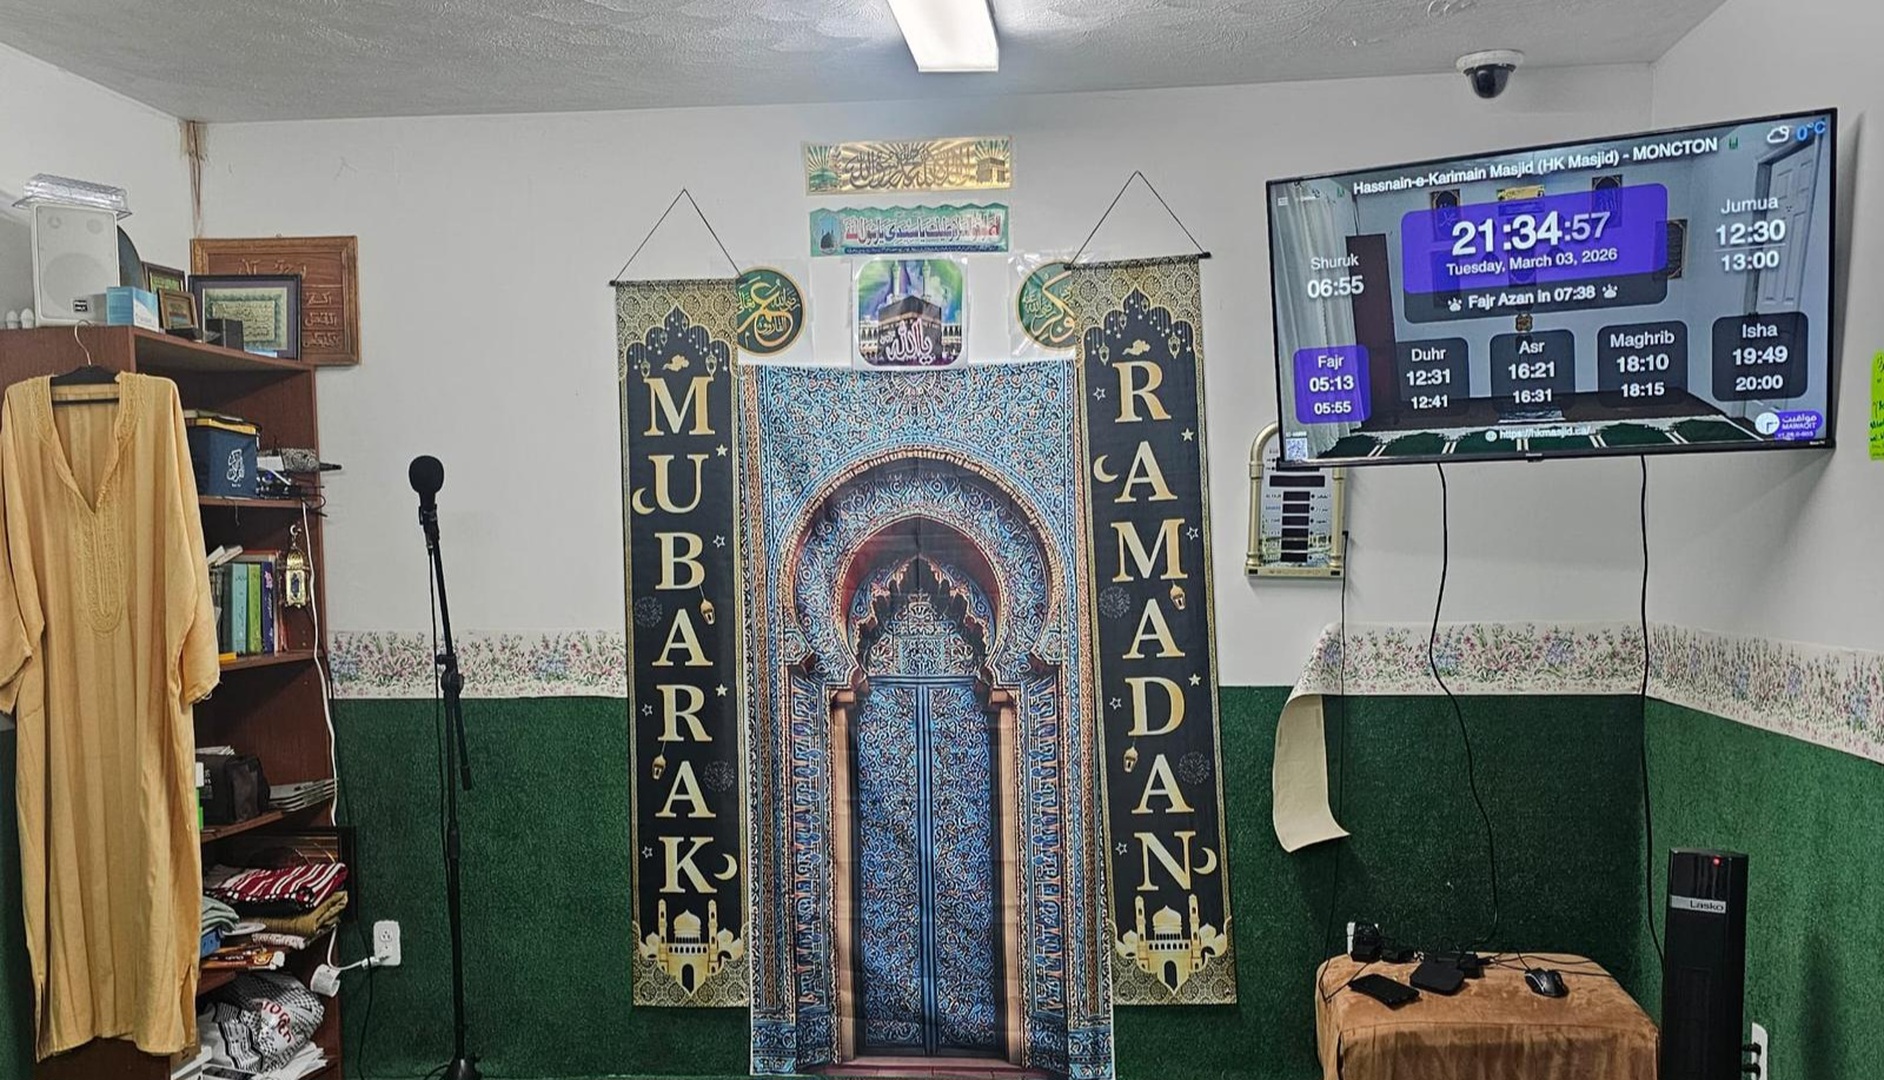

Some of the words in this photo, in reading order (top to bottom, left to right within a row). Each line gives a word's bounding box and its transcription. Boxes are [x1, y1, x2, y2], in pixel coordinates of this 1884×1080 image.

[1796, 121, 1827, 141] 0°C
[1353, 168, 1487, 196] Hassnain-e-Karimain
[1490, 160, 1534, 180] Masjid
[1537, 156, 1566, 176] (HK
[1568, 151, 1620, 170] Masjid)
[1633, 137, 1719, 162] MONCTON
[1720, 197, 1779, 214] Jumua
[1452, 211, 1611, 256] 21:34:57
[1715, 219, 1786, 246] 12:30
[1310, 253, 1359, 270] Shuruk
[1446, 261, 1505, 276] Tuesday,
[1510, 255, 1551, 270] March
[1556, 252, 1577, 266] 03,
[1582, 248, 1618, 263] 2026
[1721, 250, 1780, 272] 13:00
[1307, 275, 1365, 298] 06:55
[1469, 295, 1496, 310] Fajr
[1498, 292, 1534, 307] Azan
[1537, 290, 1550, 303] in
[1554, 285, 1596, 301] 07:38
[1610, 330, 1675, 349] Maghrib
[1742, 323, 1778, 338] Isha
[1411, 347, 1447, 362] Duhr
[1519, 340, 1545, 355] Asr
[1732, 345, 1788, 366] 19:49
[1317, 354, 1344, 371] Fajr
[1508, 361, 1556, 380] 16:21
[1616, 354, 1670, 373] 18:10
[1309, 375, 1355, 393] 05:13
[1406, 368, 1451, 386] 12:31
[1735, 374, 1784, 391] 20:00
[1512, 388, 1552, 404] 16:31
[1620, 382, 1665, 398] 18:15
[1314, 401, 1352, 415] 05:55
[1411, 394, 1449, 410] 12:41
[643, 376, 718, 893] MUBARAK
[1111, 360, 1196, 892] RAMADAN
[1690, 899, 1725, 911] Lasko
